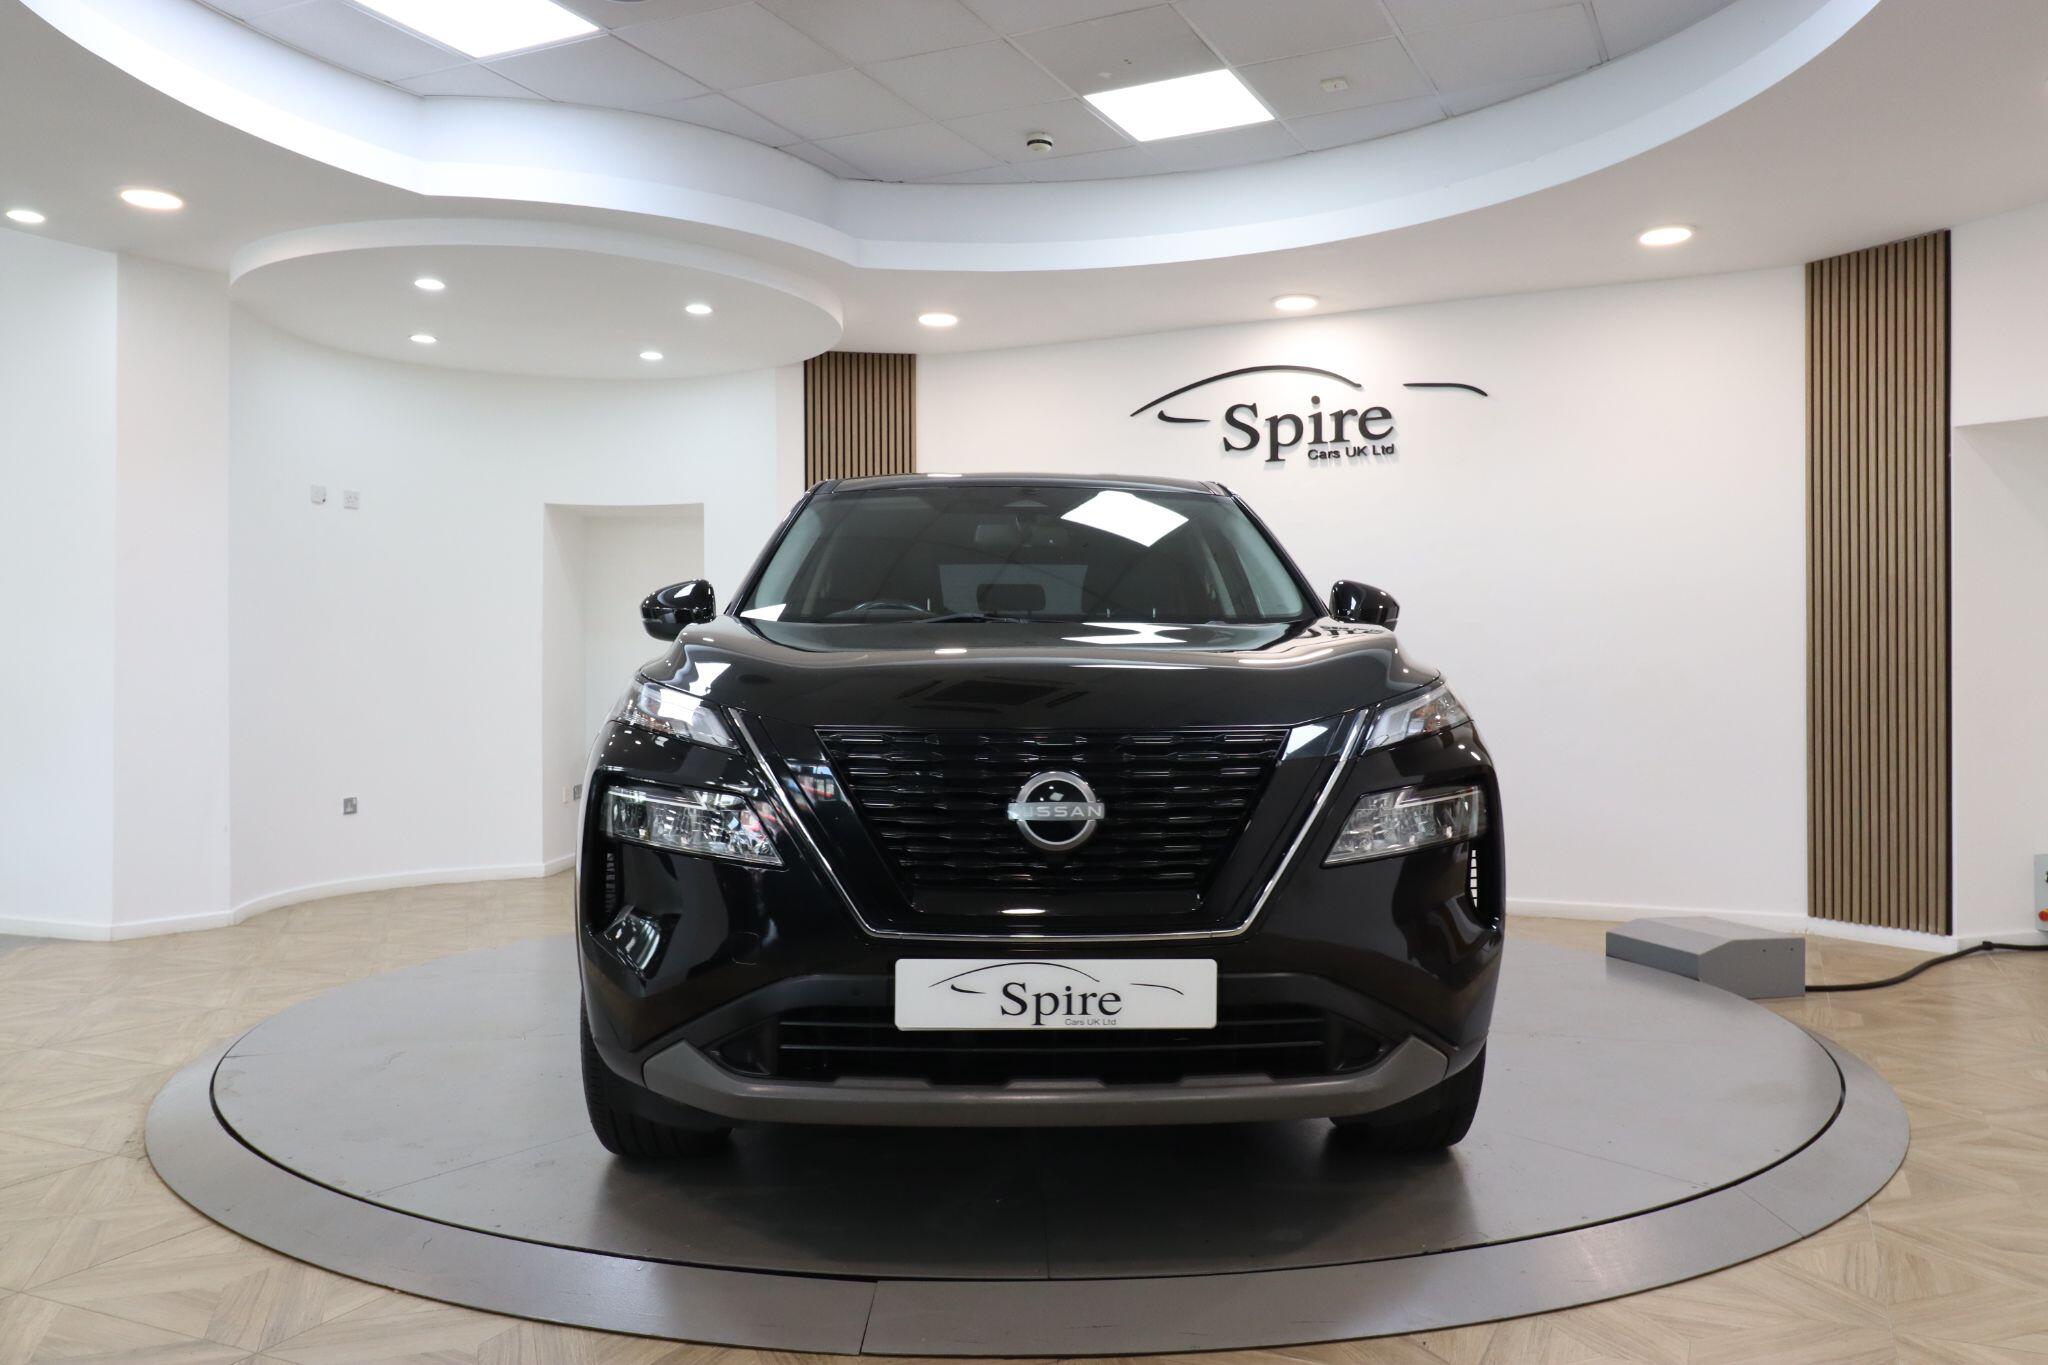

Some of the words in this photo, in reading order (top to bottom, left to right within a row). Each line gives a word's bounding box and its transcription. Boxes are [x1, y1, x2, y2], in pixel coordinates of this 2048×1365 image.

[1223, 395, 1394, 462] Spire
[1307, 449, 1341, 460] Cars
[1345, 446, 1368, 459] UK
[1372, 443, 1395, 456] Ltd
[1010, 806, 1102, 817] ISSAN
[1000, 982, 1123, 1026] Spire
[1064, 1018, 1085, 1026] Cars
[1087, 1018, 1101, 1026] UK
[1103, 1018, 1117, 1026] Ltd
